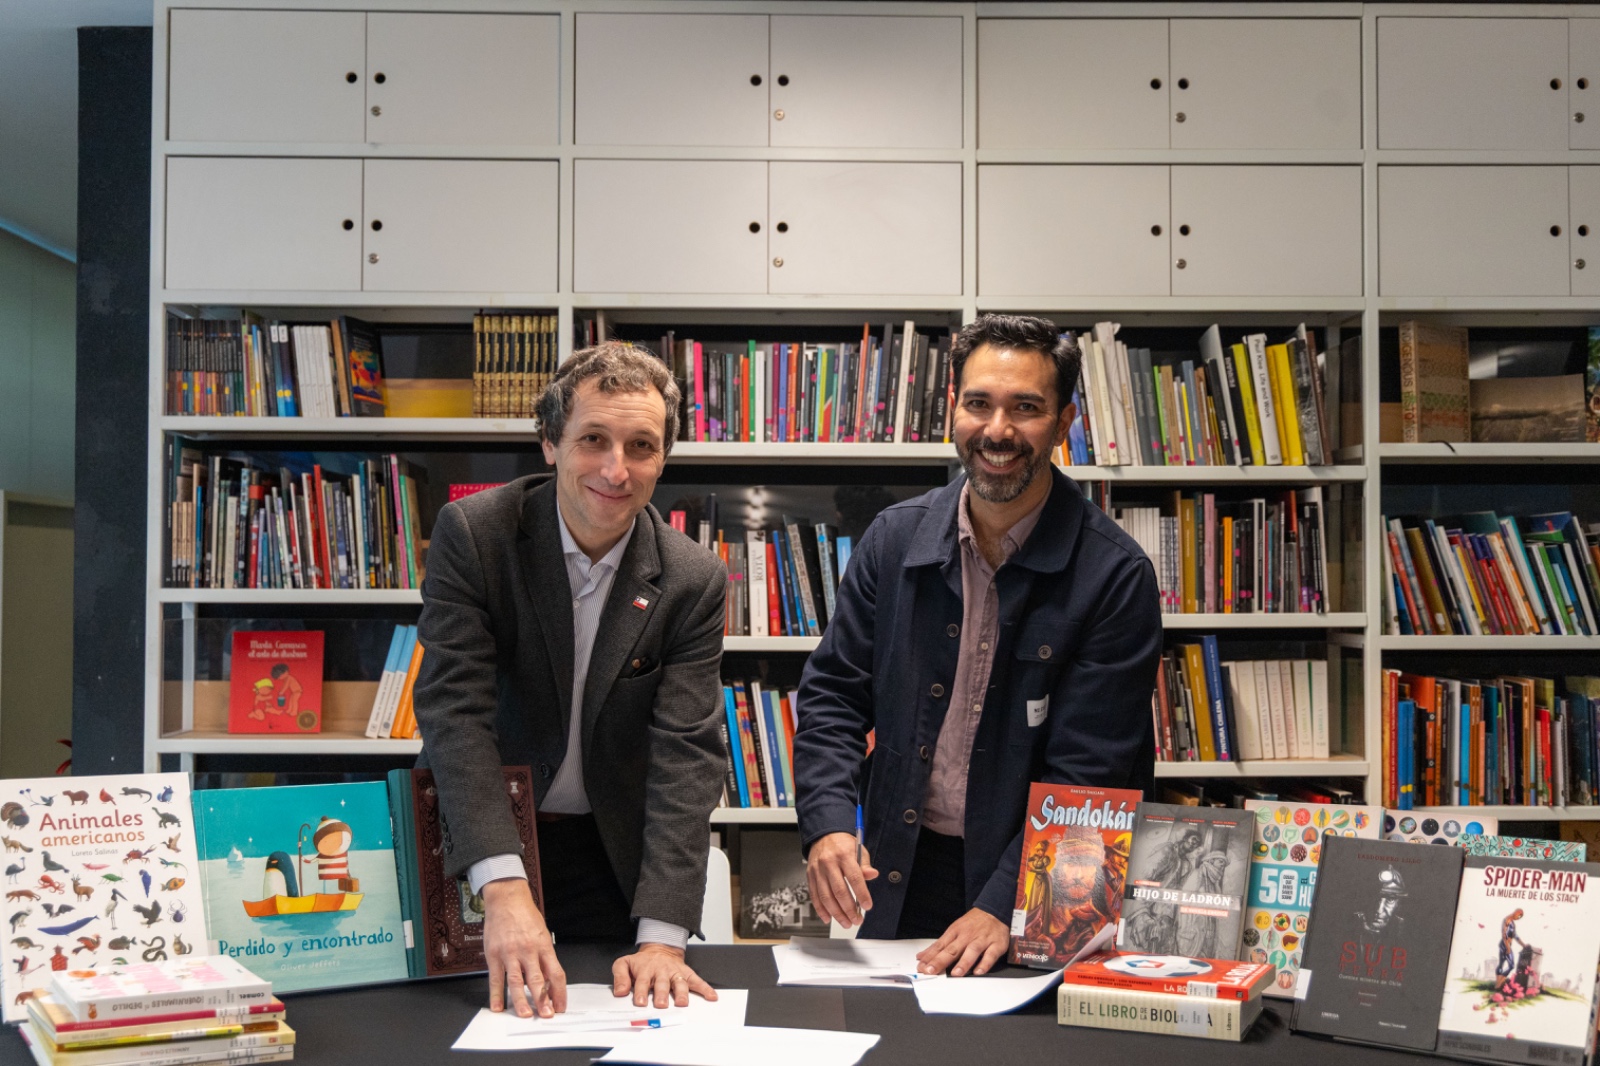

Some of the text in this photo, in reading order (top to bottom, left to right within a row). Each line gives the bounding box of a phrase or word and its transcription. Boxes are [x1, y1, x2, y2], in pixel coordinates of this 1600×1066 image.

[1253, 338, 1262, 353] Paul
[1256, 354, 1265, 369] Klee
[1258, 372, 1267, 385] Life
[1263, 401, 1271, 418] Work
[756, 554, 764, 581] ROTA
[1215, 699, 1228, 754] PINTURA CHILENA
[39, 809, 143, 831] Animales
[41, 830, 145, 847] americanos
[71, 848, 118, 857] Loreto Salinas
[1258, 867, 1299, 906] 50
[1483, 866, 1588, 893] SPIDER-MAN
[1133, 888, 1231, 907] HIJO DE LADRÓN
[1486, 888, 1580, 904] LA MUERTE DE LOS STACY
[218, 927, 394, 958] Perdido y encontrado
[1341, 941, 1407, 969] SUB
[280, 960, 340, 971] Oliver Jeffers
[1164, 983, 1175, 992] LA
[112, 1001, 143, 1012] DEDILLO
[1079, 1002, 1094, 1015] EL
[1099, 1003, 1137, 1020] LIBRO
